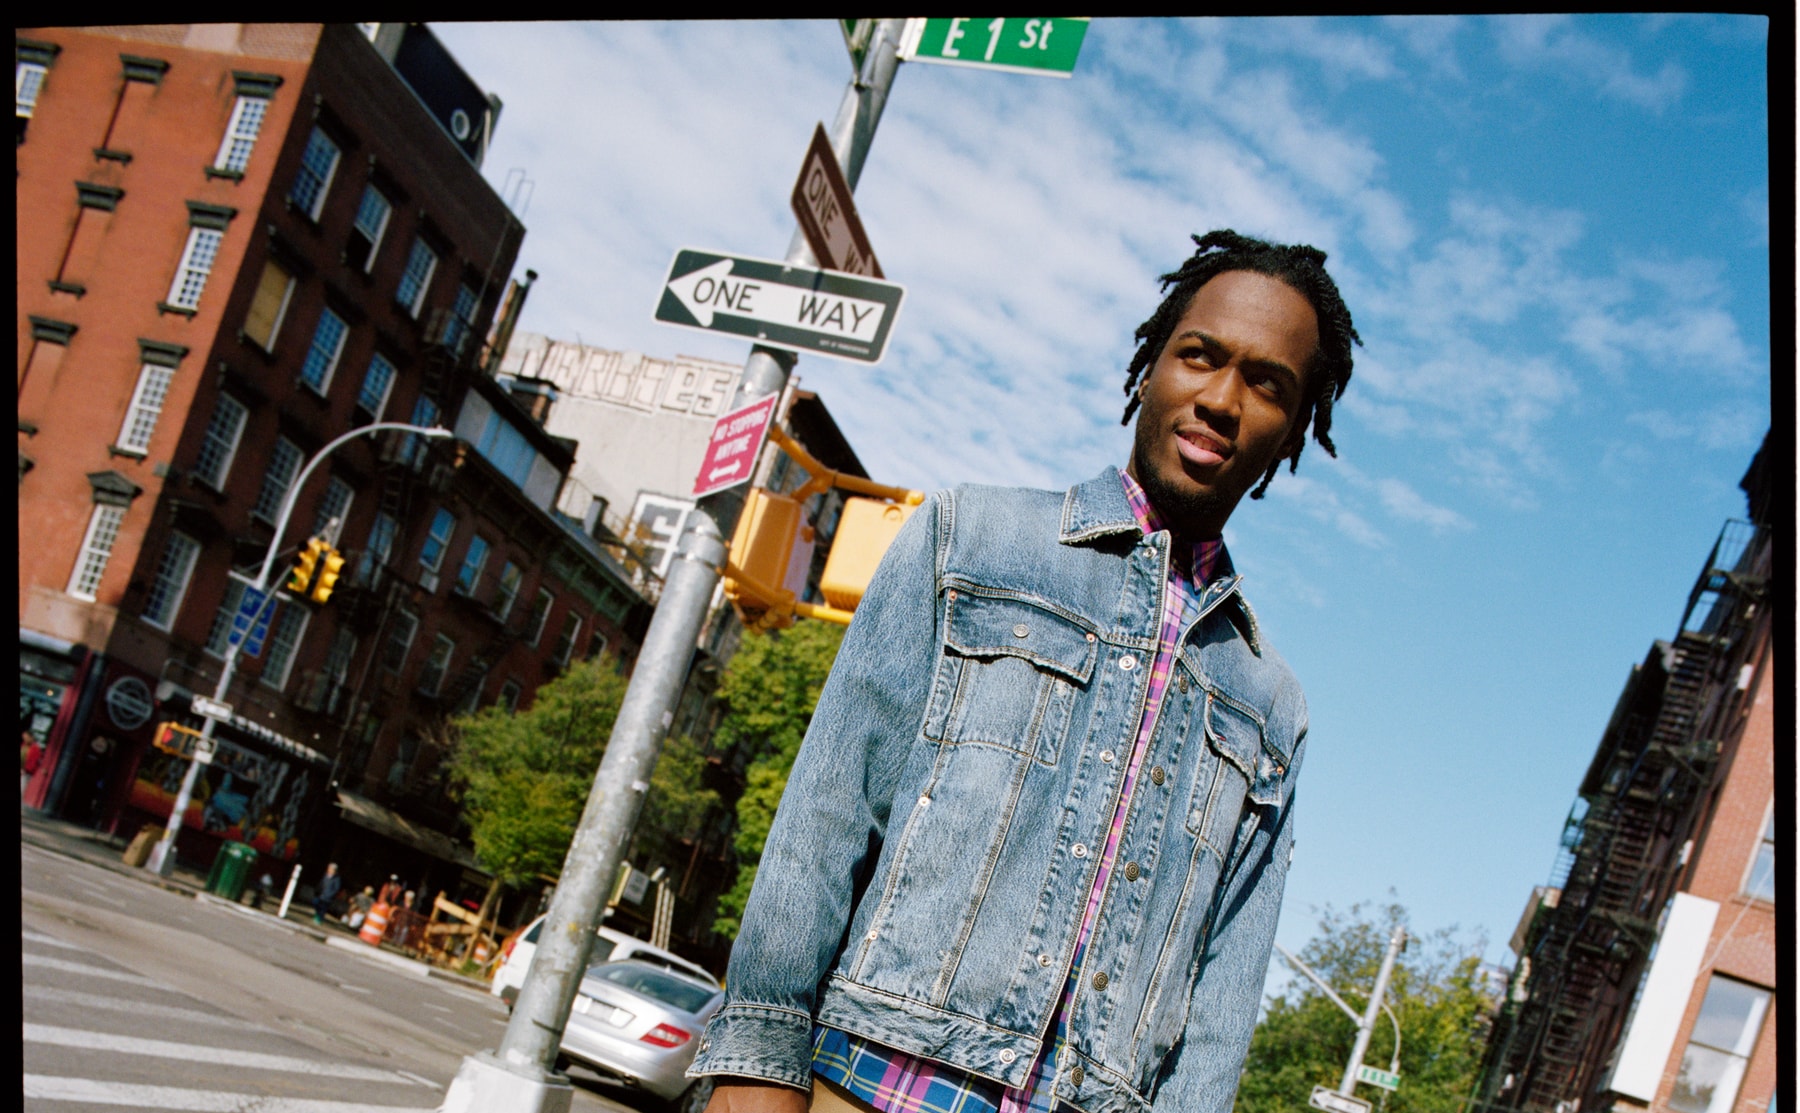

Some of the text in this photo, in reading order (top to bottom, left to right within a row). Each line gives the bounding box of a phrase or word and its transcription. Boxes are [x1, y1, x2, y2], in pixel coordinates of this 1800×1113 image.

[941, 17, 1053, 61] E 1 St
[809, 168, 838, 240] ONE
[693, 277, 874, 333] ONE WAY
[727, 406, 769, 437] STOPPING
[714, 433, 752, 462] ANYTIME
